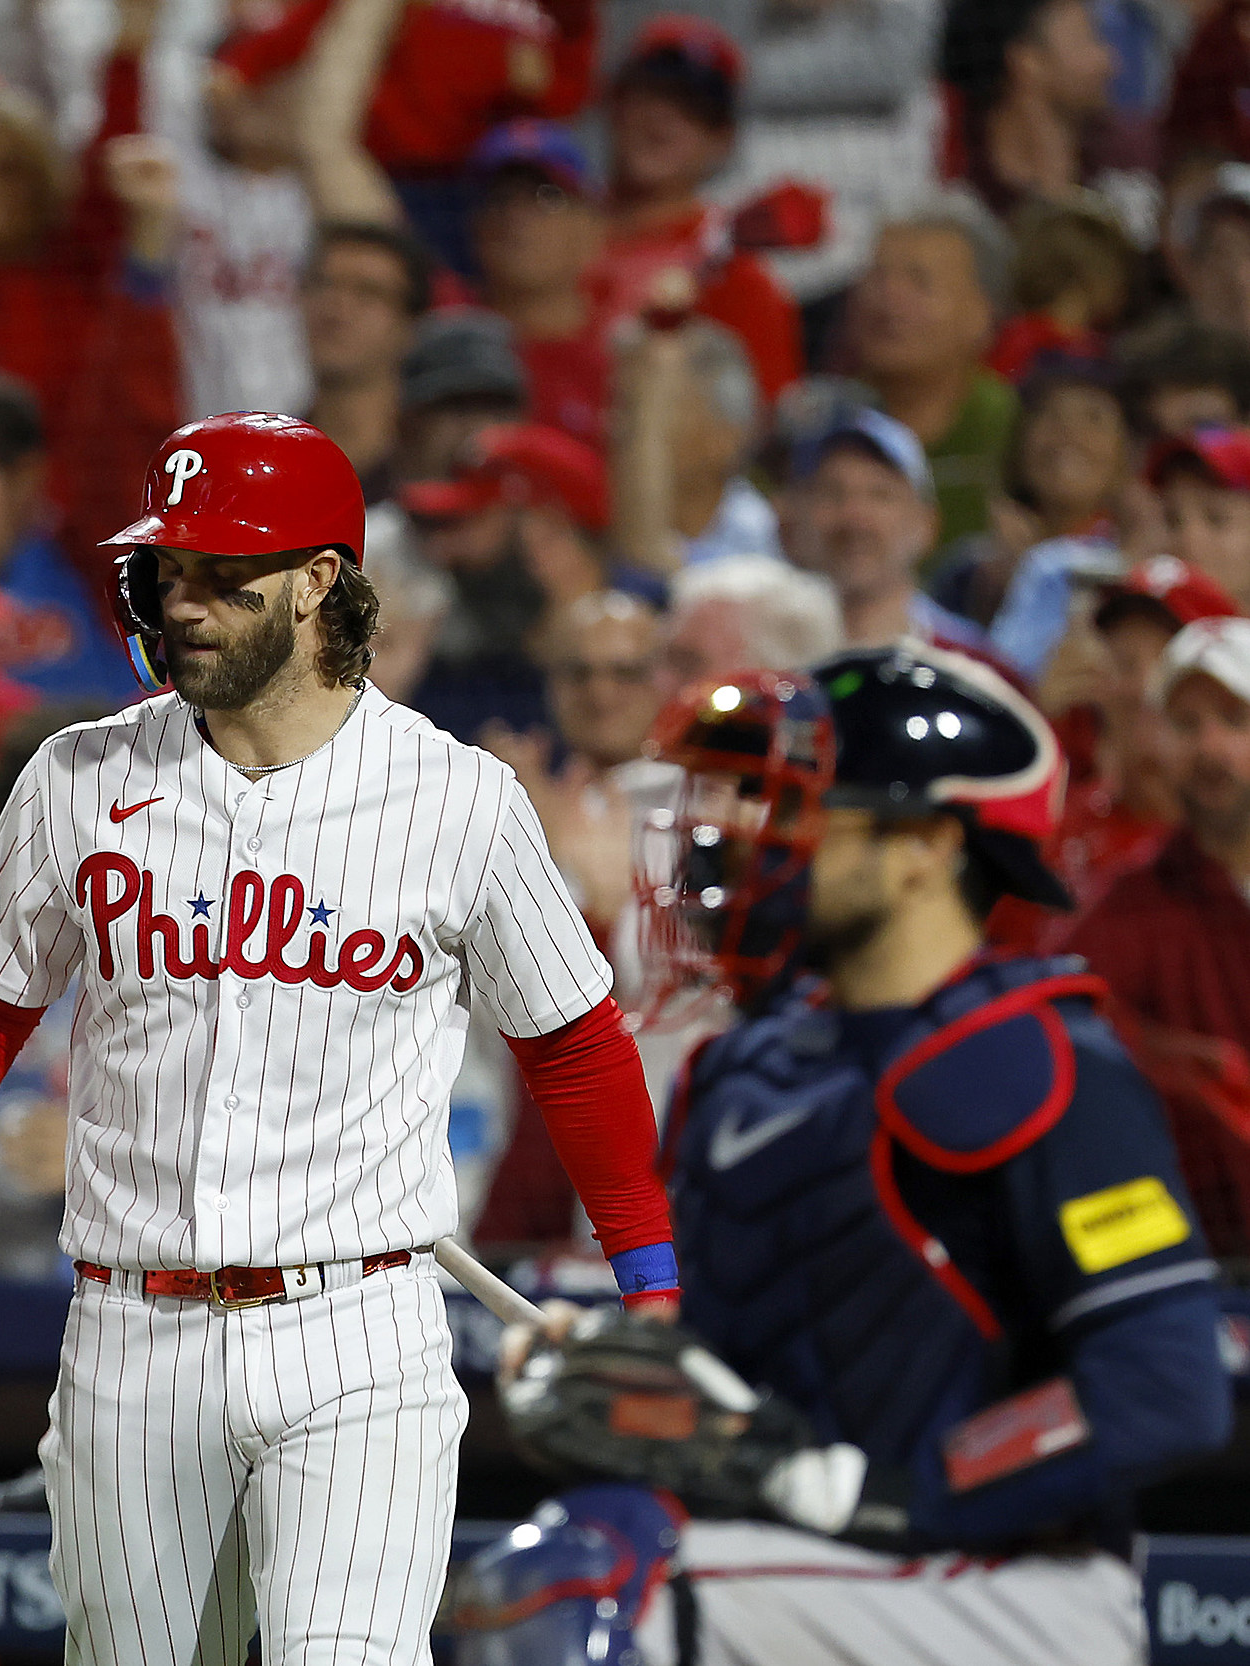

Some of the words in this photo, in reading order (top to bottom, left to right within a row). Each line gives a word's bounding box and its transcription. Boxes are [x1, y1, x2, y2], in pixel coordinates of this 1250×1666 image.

[165, 449, 203, 505] P
[76, 851, 425, 993] Phillies
[293, 1264, 307, 1286] 3
